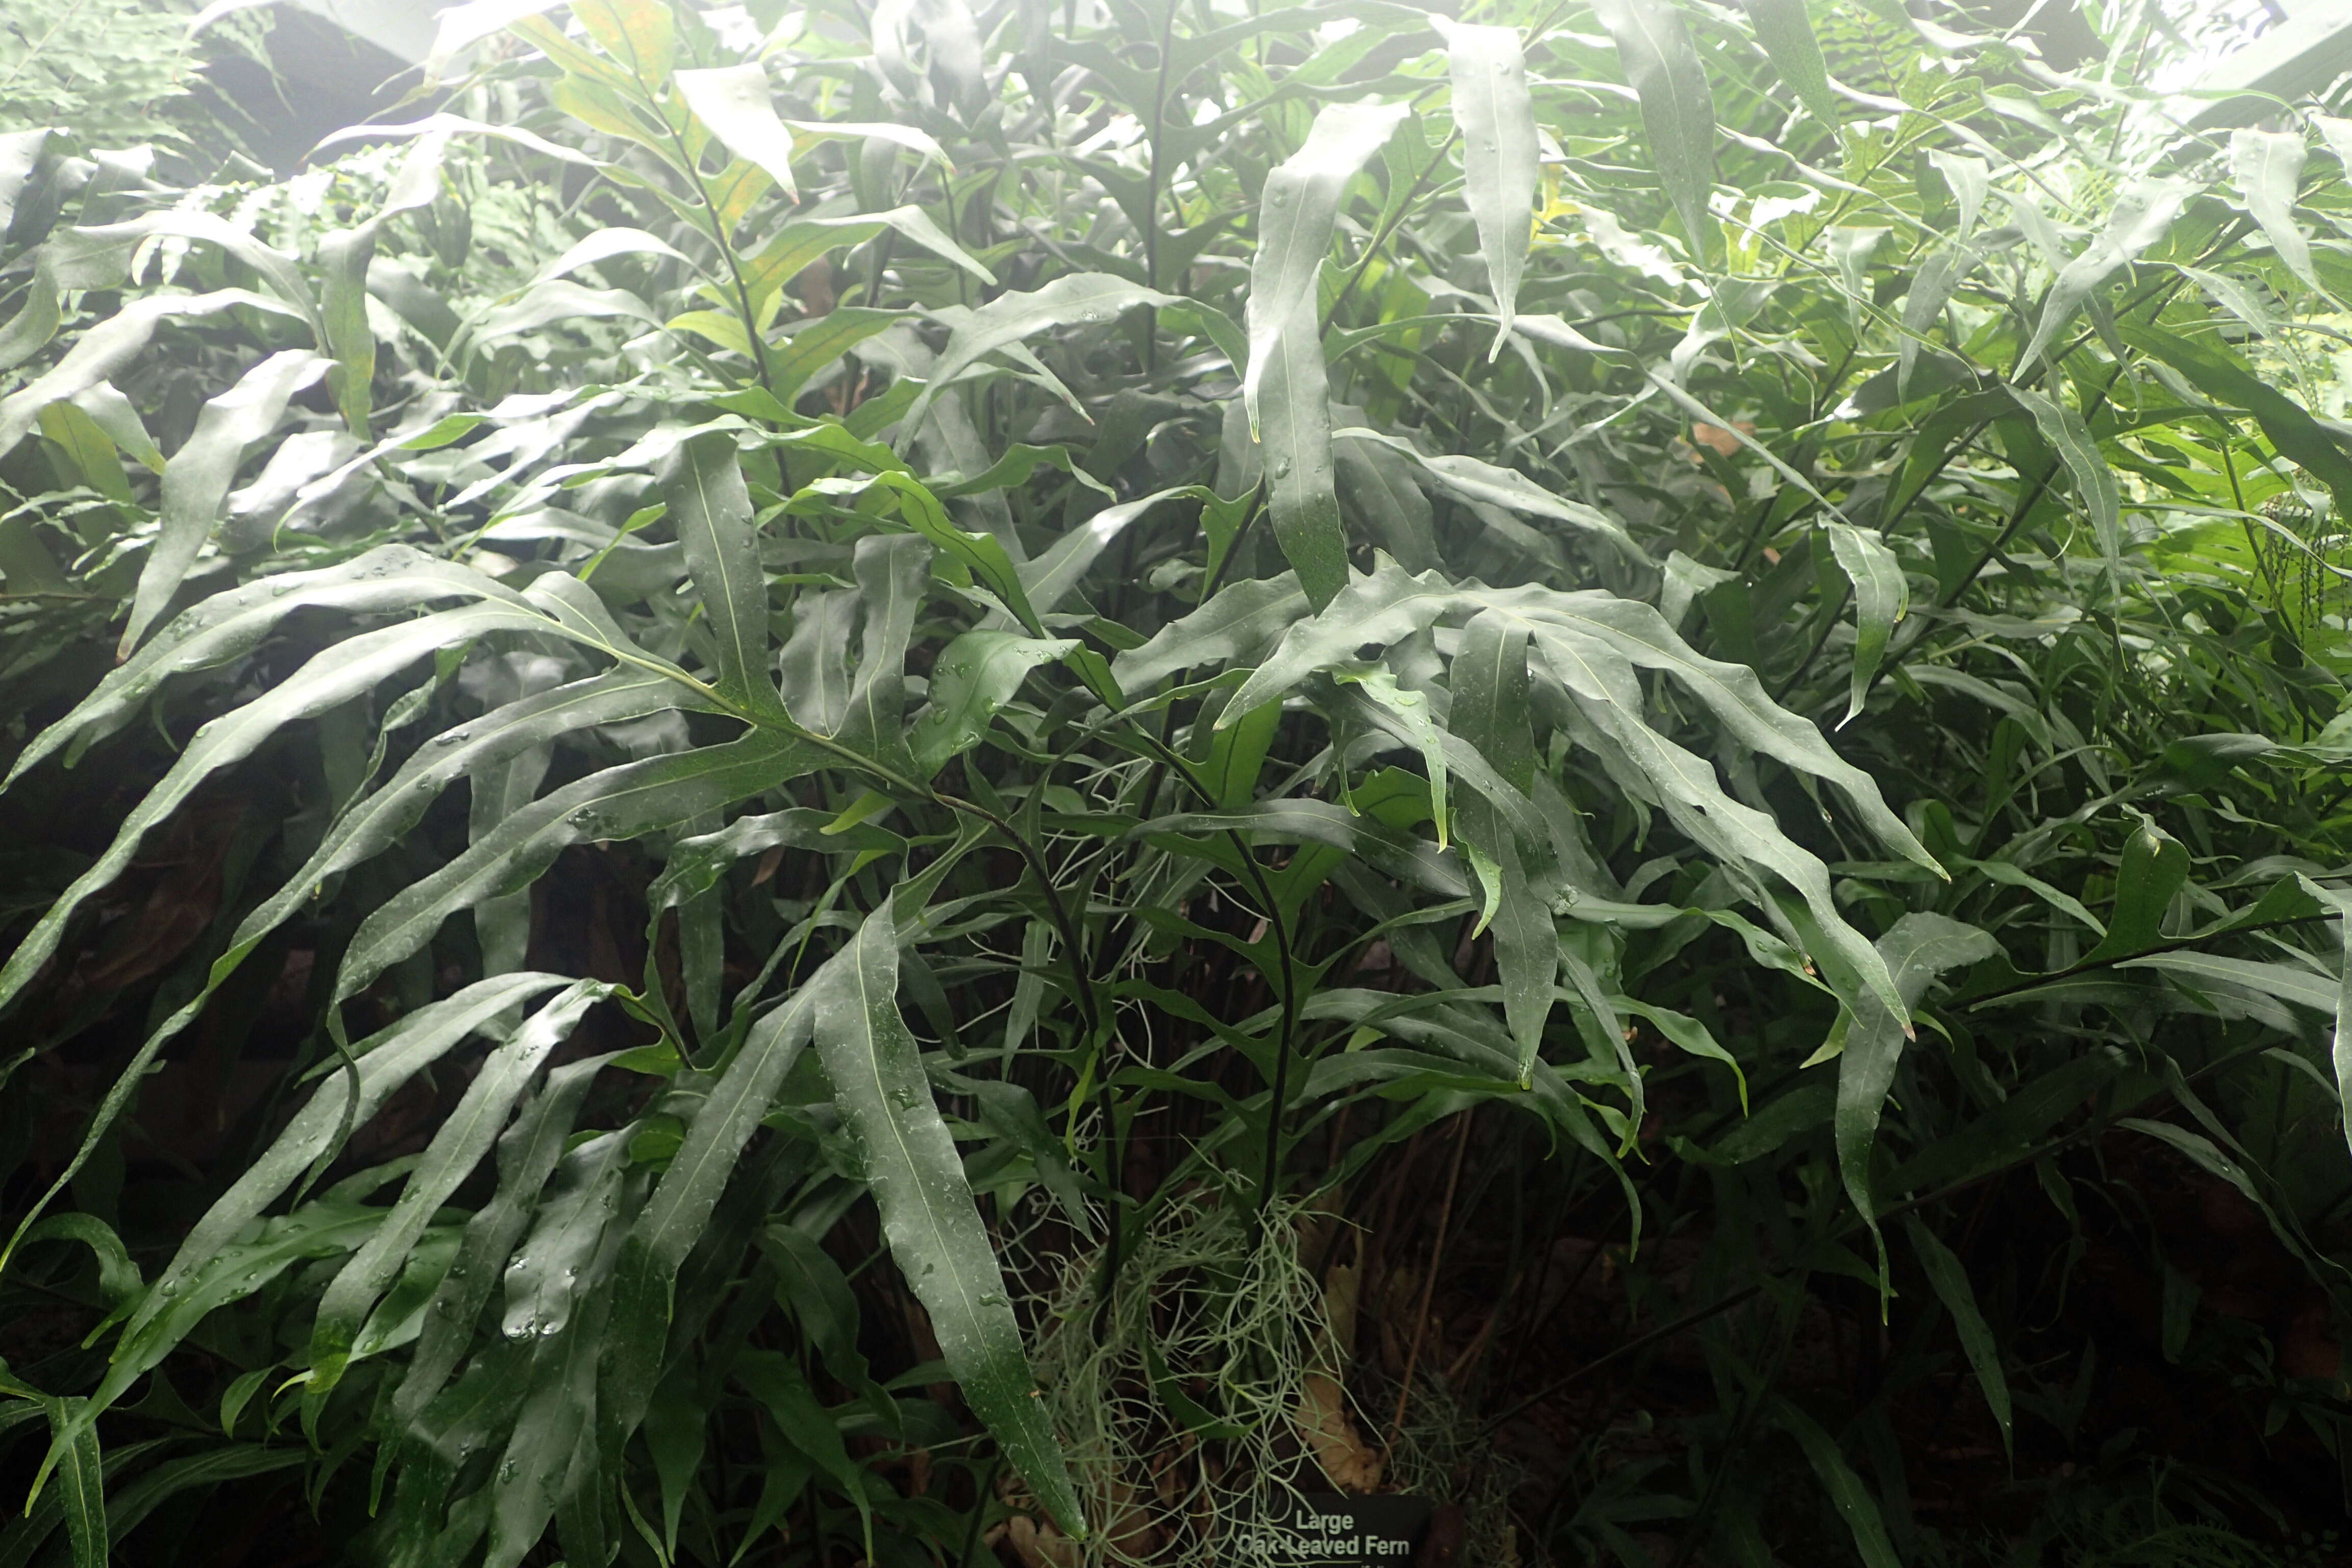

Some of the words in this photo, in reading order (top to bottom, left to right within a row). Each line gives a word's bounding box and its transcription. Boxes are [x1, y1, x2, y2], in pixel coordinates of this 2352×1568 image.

[1296, 1510, 1354, 1534] Large
[1238, 1534, 1359, 1555] Oak-Leaved
[1365, 1535, 1409, 1555] Fern
